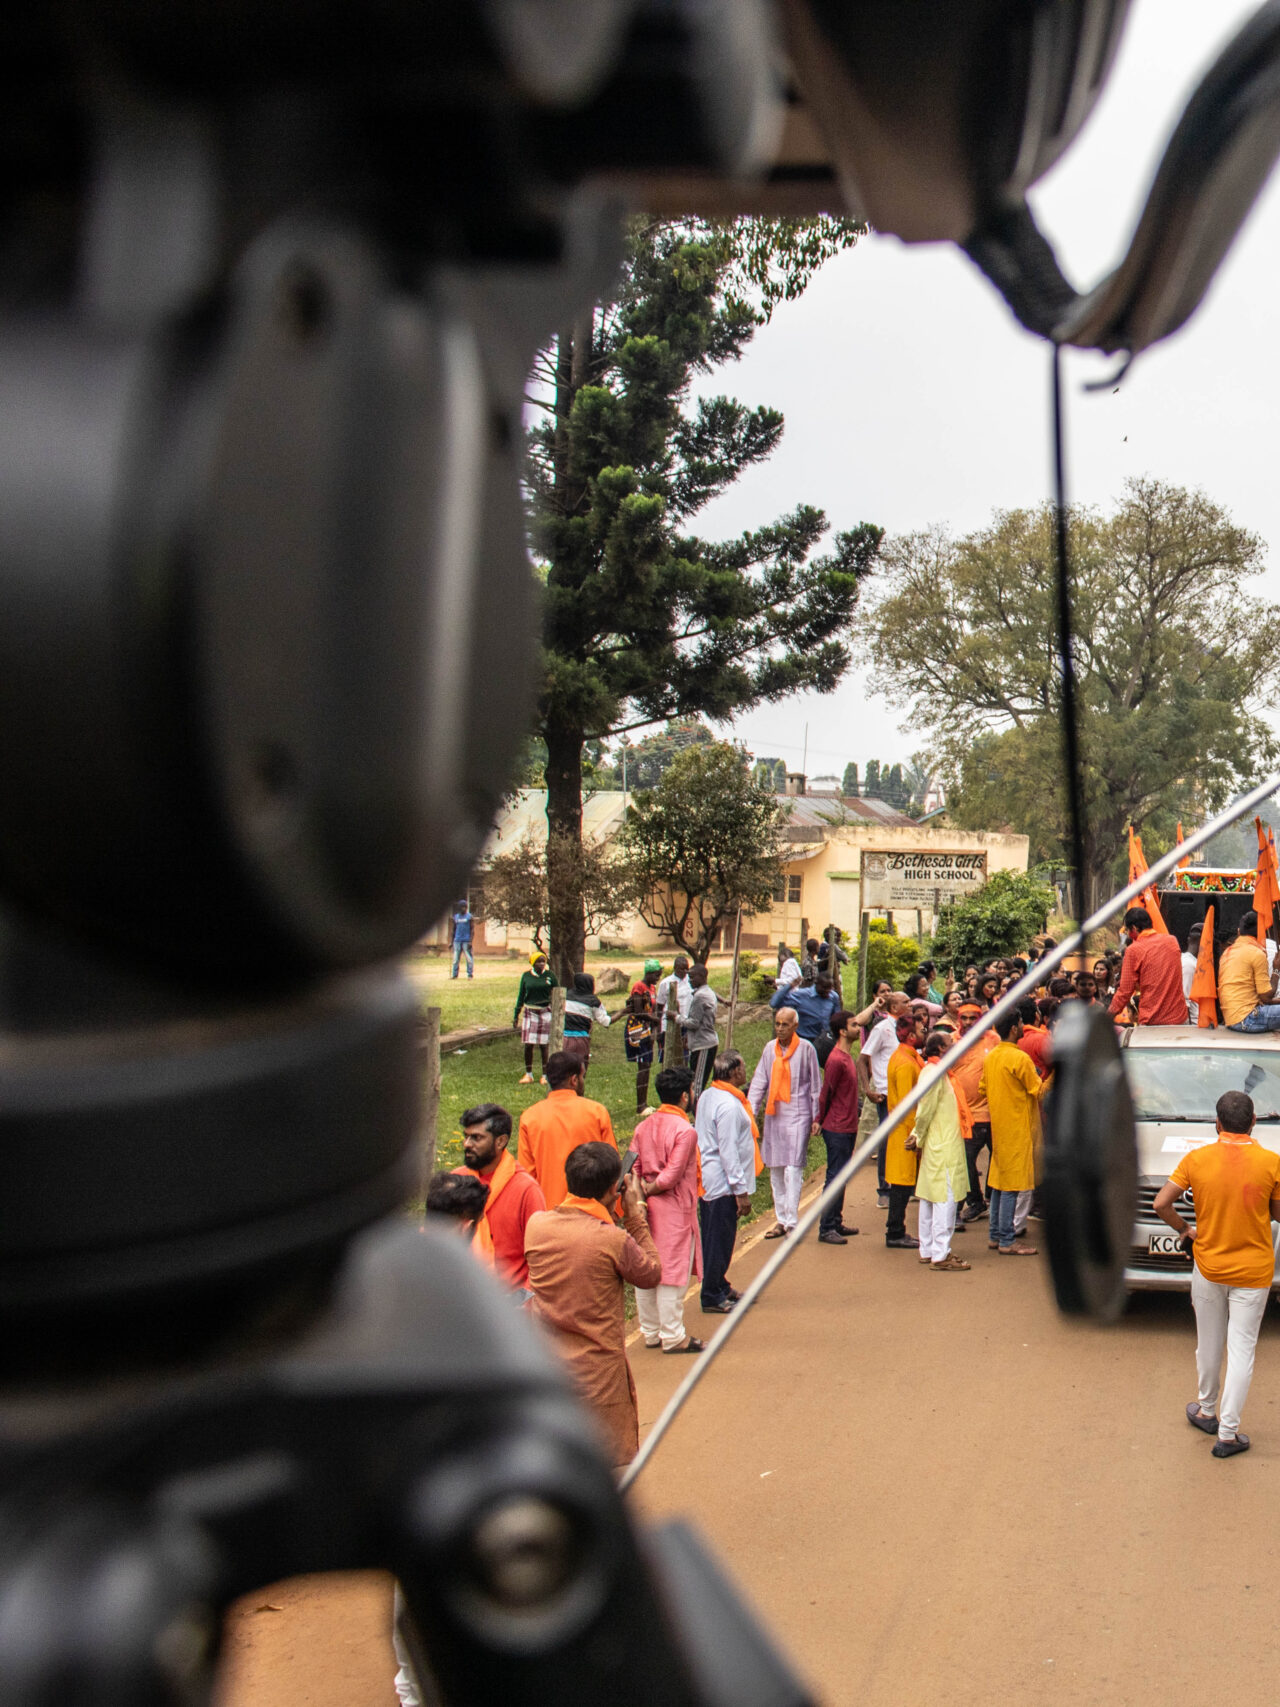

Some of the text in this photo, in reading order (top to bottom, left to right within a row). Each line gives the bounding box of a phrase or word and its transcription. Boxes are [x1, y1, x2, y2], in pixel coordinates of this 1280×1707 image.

[887, 852, 984, 870] Bethesda Girls
[904, 869, 977, 880] HIGH SCHOOL
